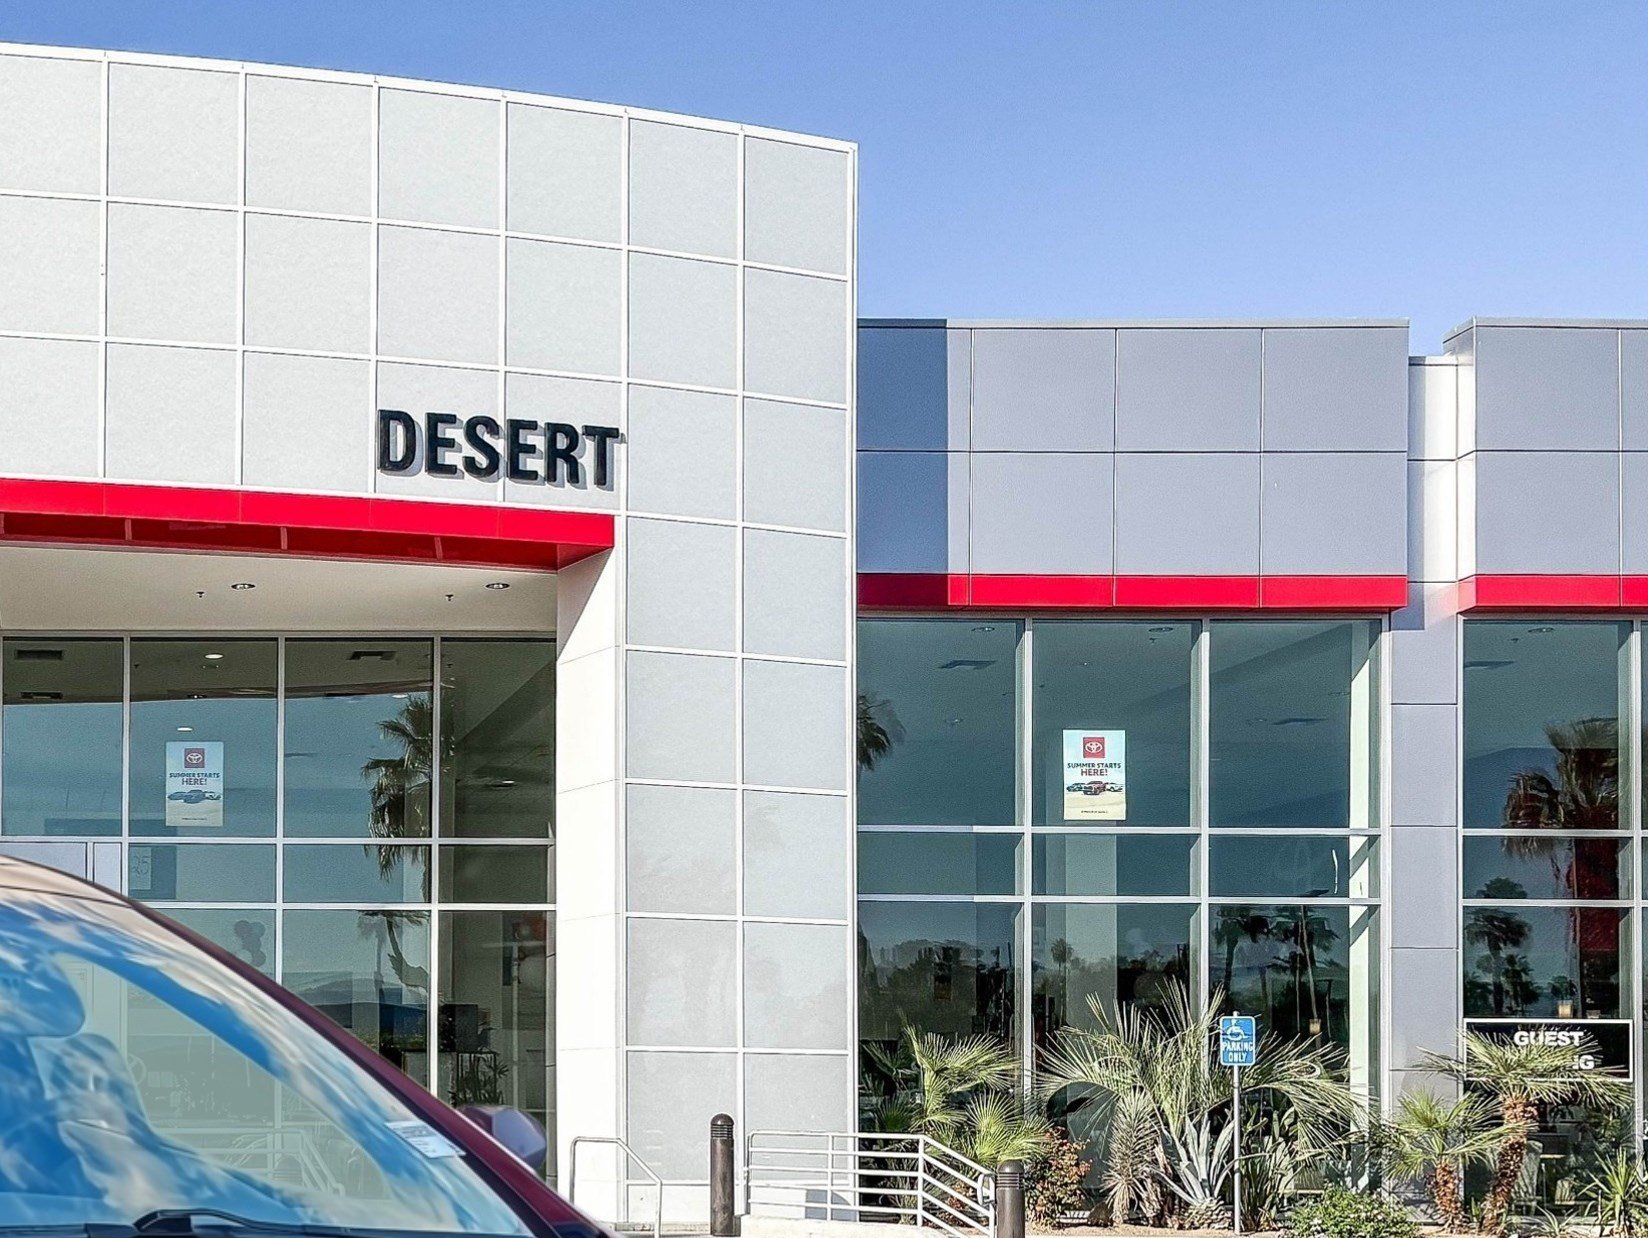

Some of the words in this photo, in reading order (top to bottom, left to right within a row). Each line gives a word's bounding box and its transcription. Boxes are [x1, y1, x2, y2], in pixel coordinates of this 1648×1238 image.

[377, 409, 620, 487] DESERT
[1080, 768, 1108, 777] HERE!
[181, 777, 208, 786] HERE!
[1513, 1031, 1585, 1047] GUEST
[1222, 1041, 1254, 1051] PARKING
[1228, 1052, 1248, 1062] ONLY
